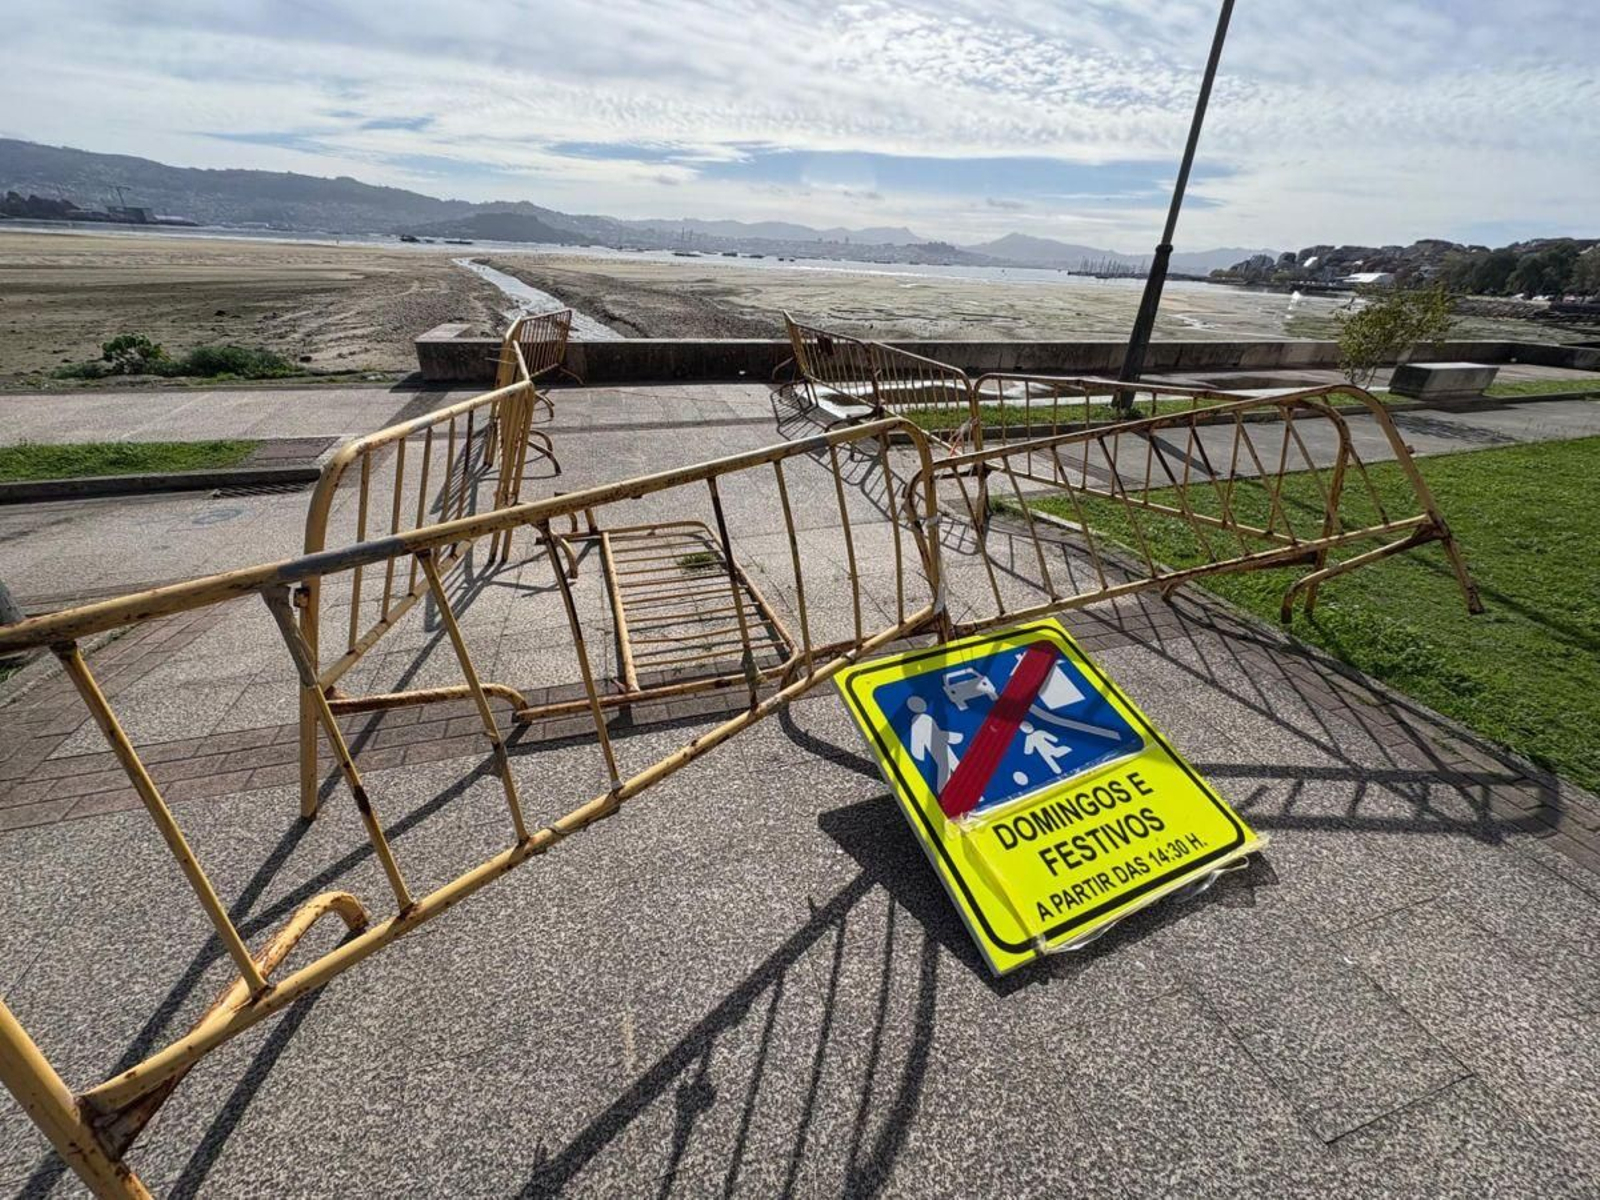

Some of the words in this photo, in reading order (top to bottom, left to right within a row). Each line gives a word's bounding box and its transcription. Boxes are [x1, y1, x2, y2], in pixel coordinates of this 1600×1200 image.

[992, 780, 1132, 850] DOMINGOS
[1126, 772, 1154, 796] E
[1038, 807, 1165, 877] FESTIVOS
[1036, 901, 1054, 922] A
[1049, 871, 1117, 914] PARTIR
[1112, 856, 1151, 885] DAS
[1148, 838, 1190, 867] 14:30
[1184, 832, 1208, 851] H.
